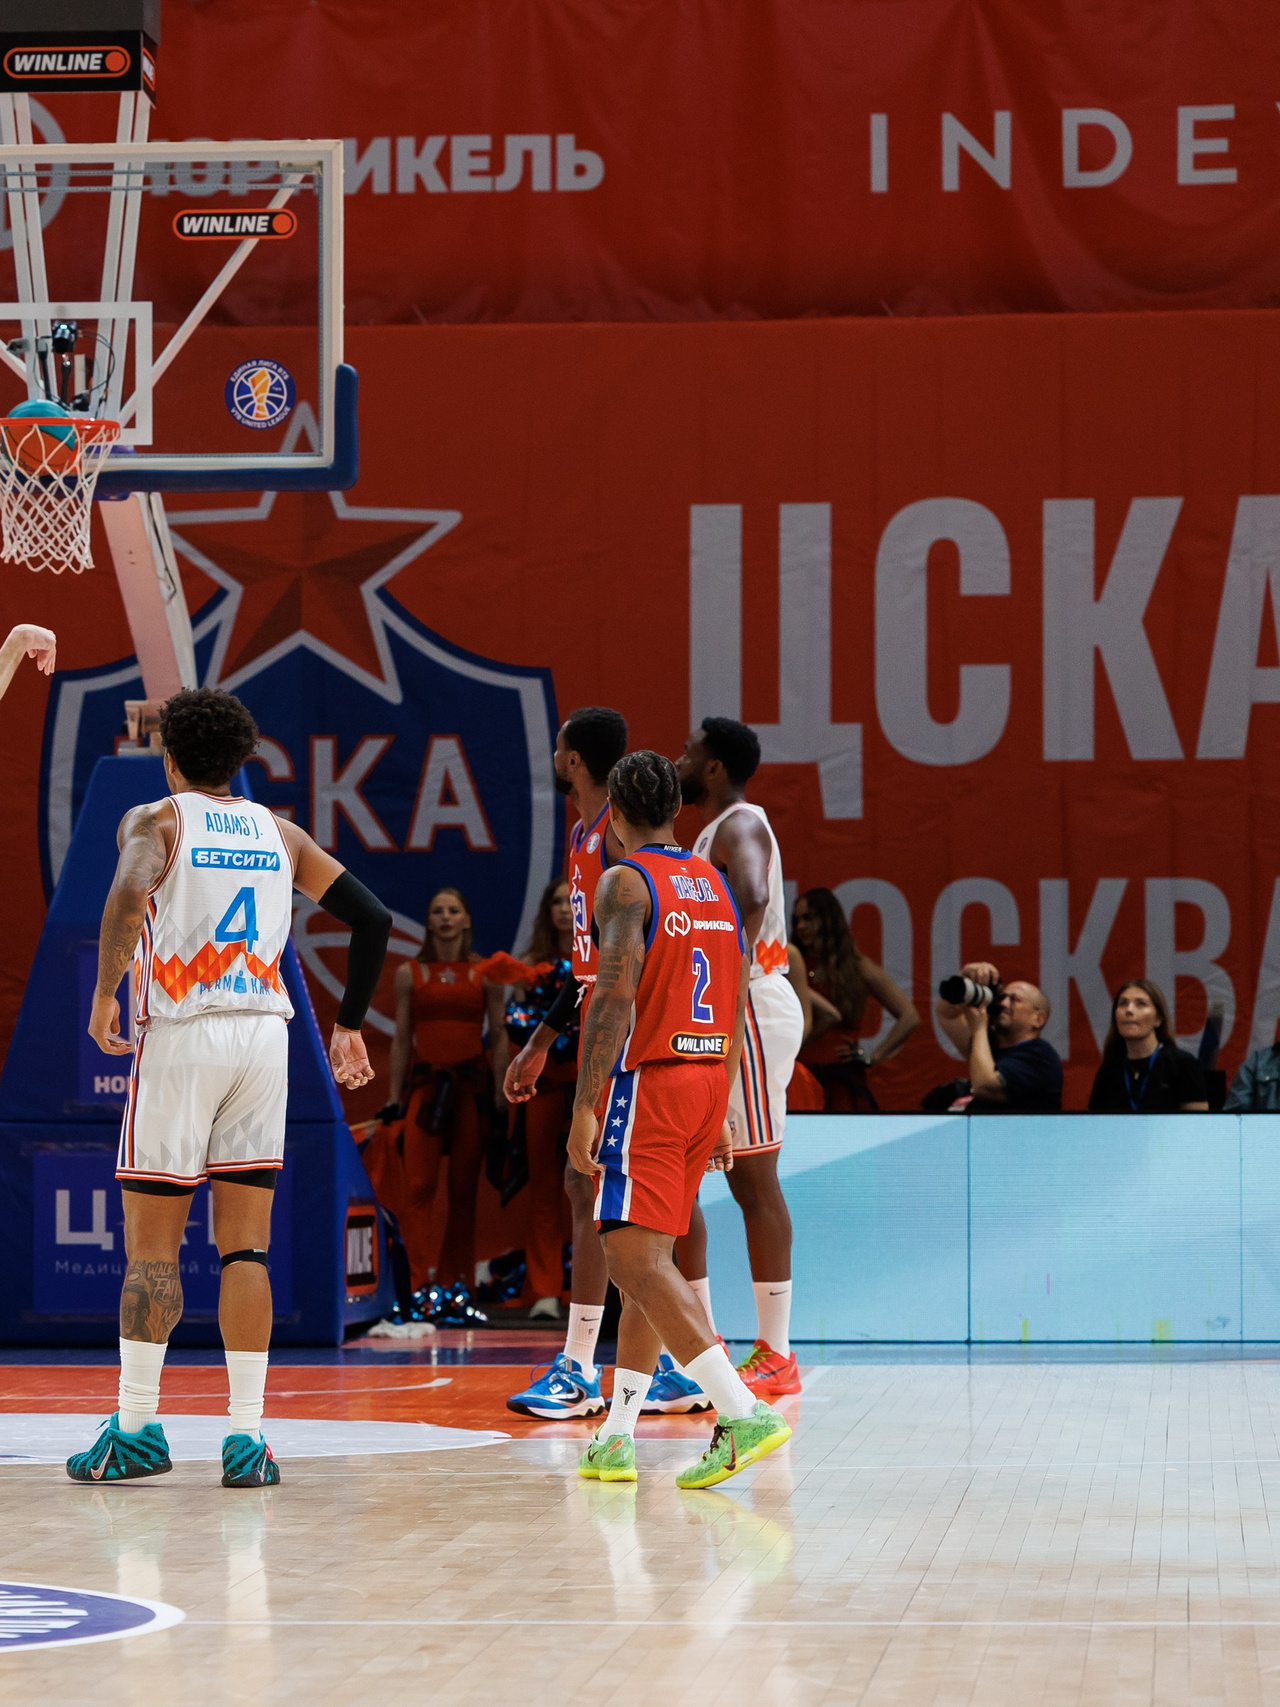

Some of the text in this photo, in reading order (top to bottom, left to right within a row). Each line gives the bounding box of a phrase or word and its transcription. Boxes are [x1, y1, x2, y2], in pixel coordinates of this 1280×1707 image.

[14, 53, 103, 72] WINLINE
[869, 103, 1280, 194] INDE
[183, 215, 270, 234] WINLINE
[206, 811, 264, 839] ADAMS J.
[196, 850, 278, 868] БЕТСИТИ
[215, 886, 259, 954] 4
[199, 974, 232, 996] PERM
[691, 947, 714, 1024] 2
